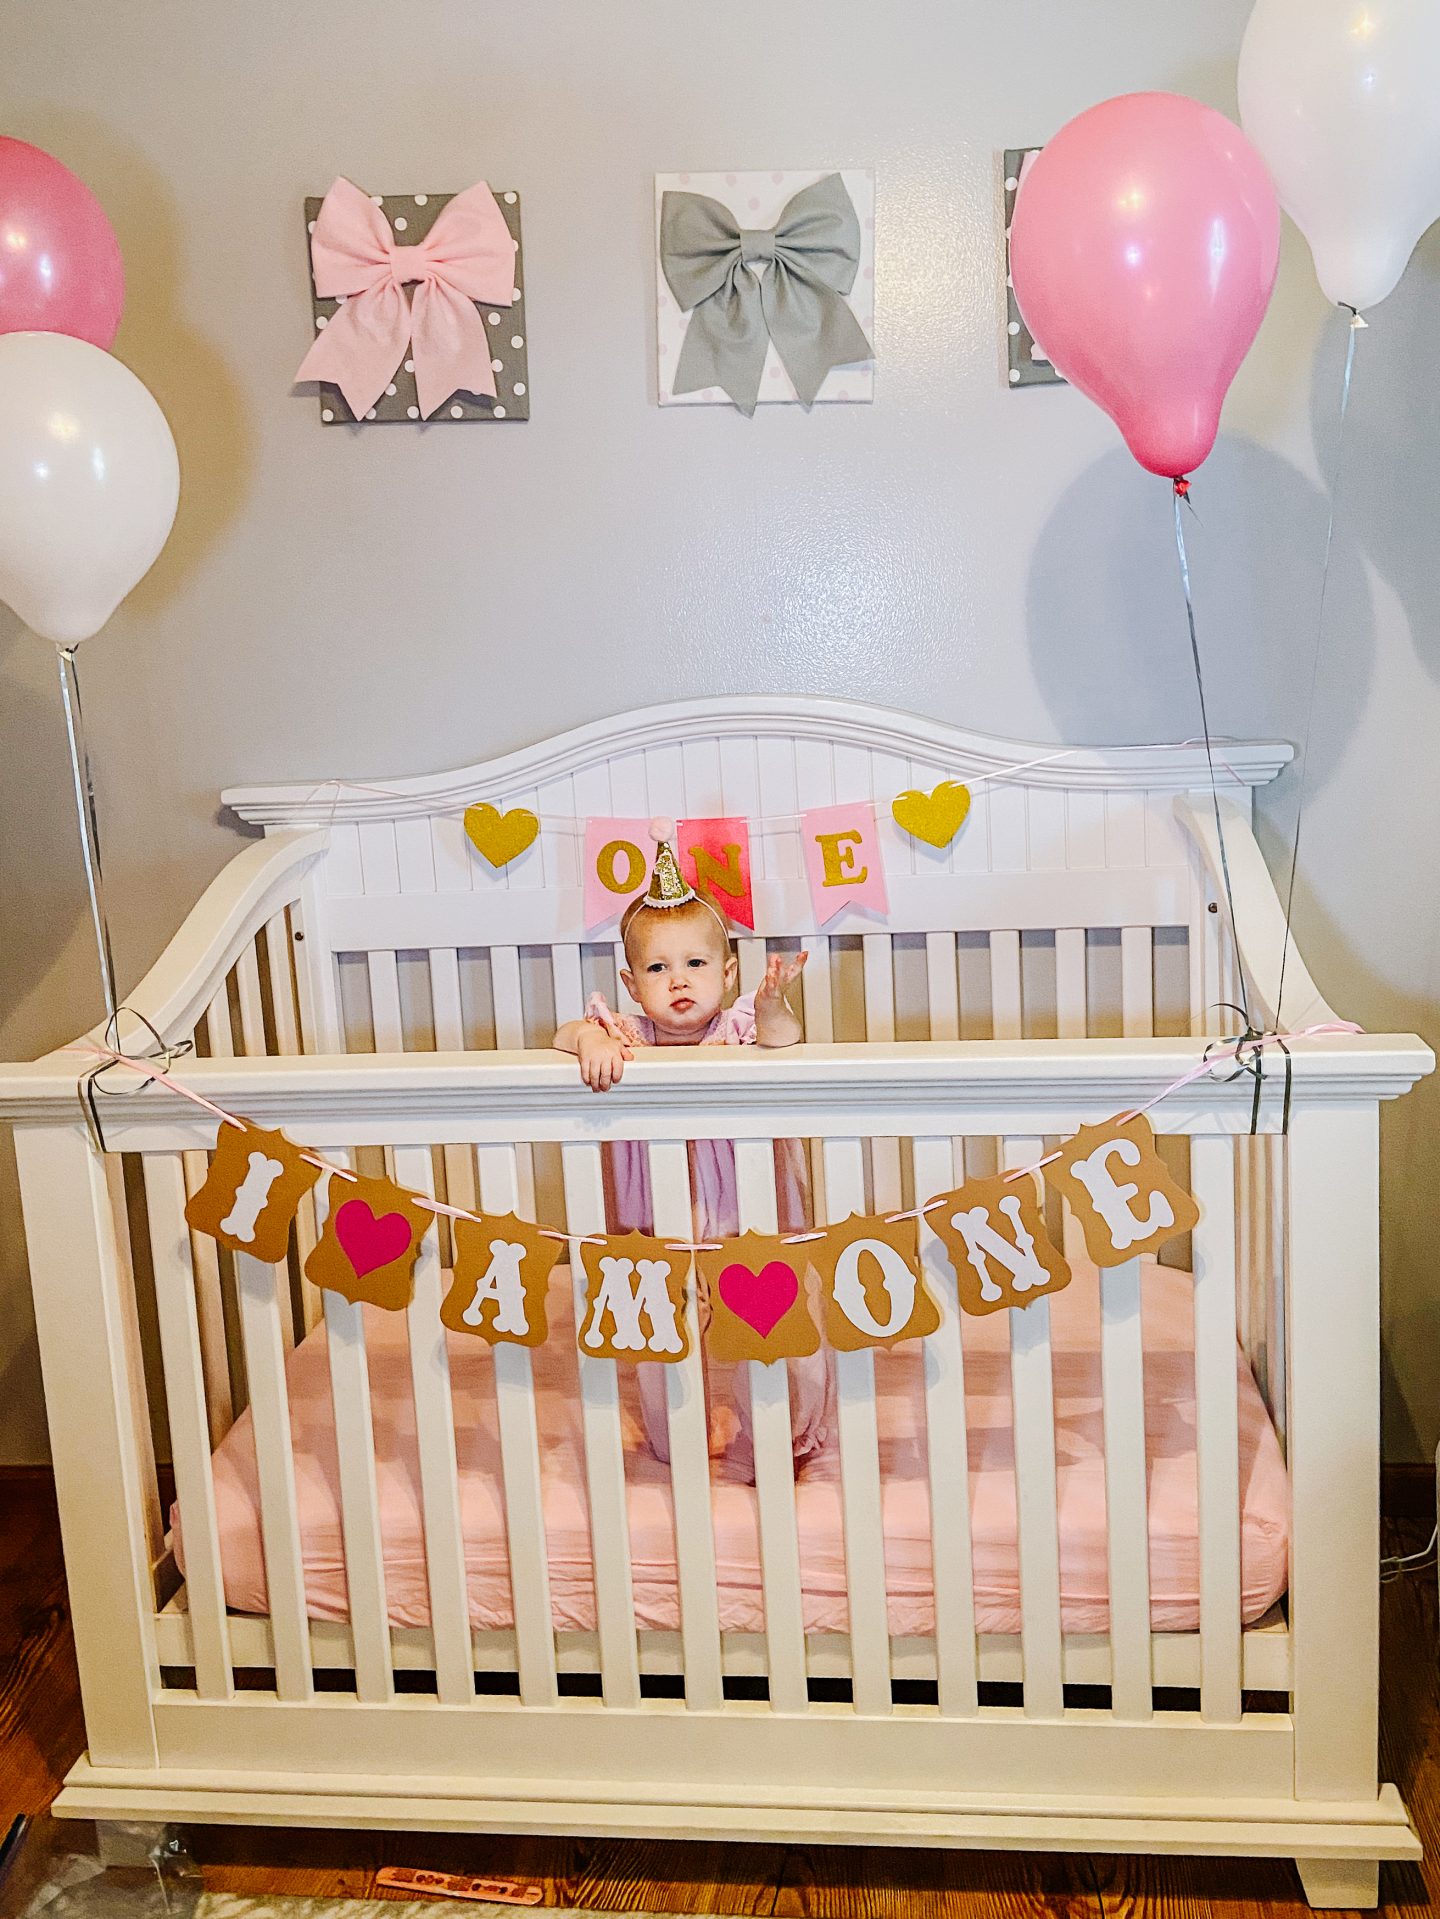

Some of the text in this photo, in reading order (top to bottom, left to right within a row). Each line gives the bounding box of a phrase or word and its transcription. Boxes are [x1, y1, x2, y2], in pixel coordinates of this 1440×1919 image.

[596, 829, 869, 898] ONE
[654, 849, 684, 897] 1
[219, 1138, 1175, 1354] I AM ONE
